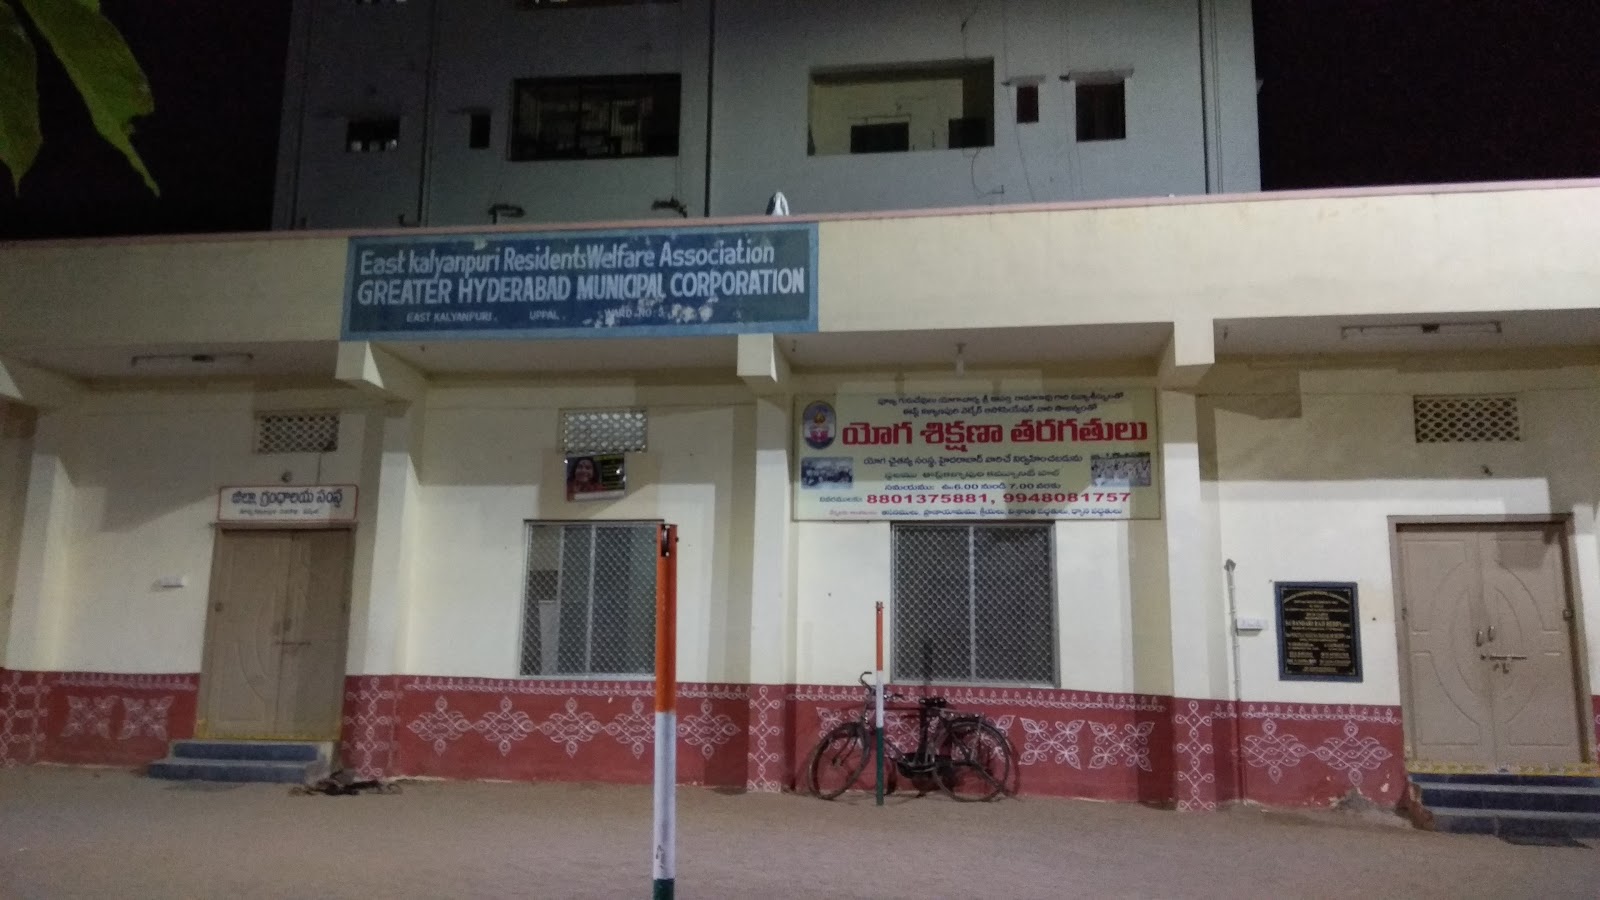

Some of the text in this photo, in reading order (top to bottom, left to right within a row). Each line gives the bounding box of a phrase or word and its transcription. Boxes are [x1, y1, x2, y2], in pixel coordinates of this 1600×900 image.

[360, 250, 405, 275] East
[408, 248, 500, 283] kalyanpuri
[586, 243, 655, 269] Welfare
[659, 239, 774, 267] Association
[357, 267, 805, 305] GREATER HYDERABAD MUNICIPAL CORPORATION
[407, 312, 430, 322] EAST
[842, 418, 1148, 452] యోగ శిక్షణా తరగతులు
[863, 456, 886, 465] యోగ
[866, 493, 995, 505] 8801375881,
[1003, 492, 1131, 504] 9948081757
